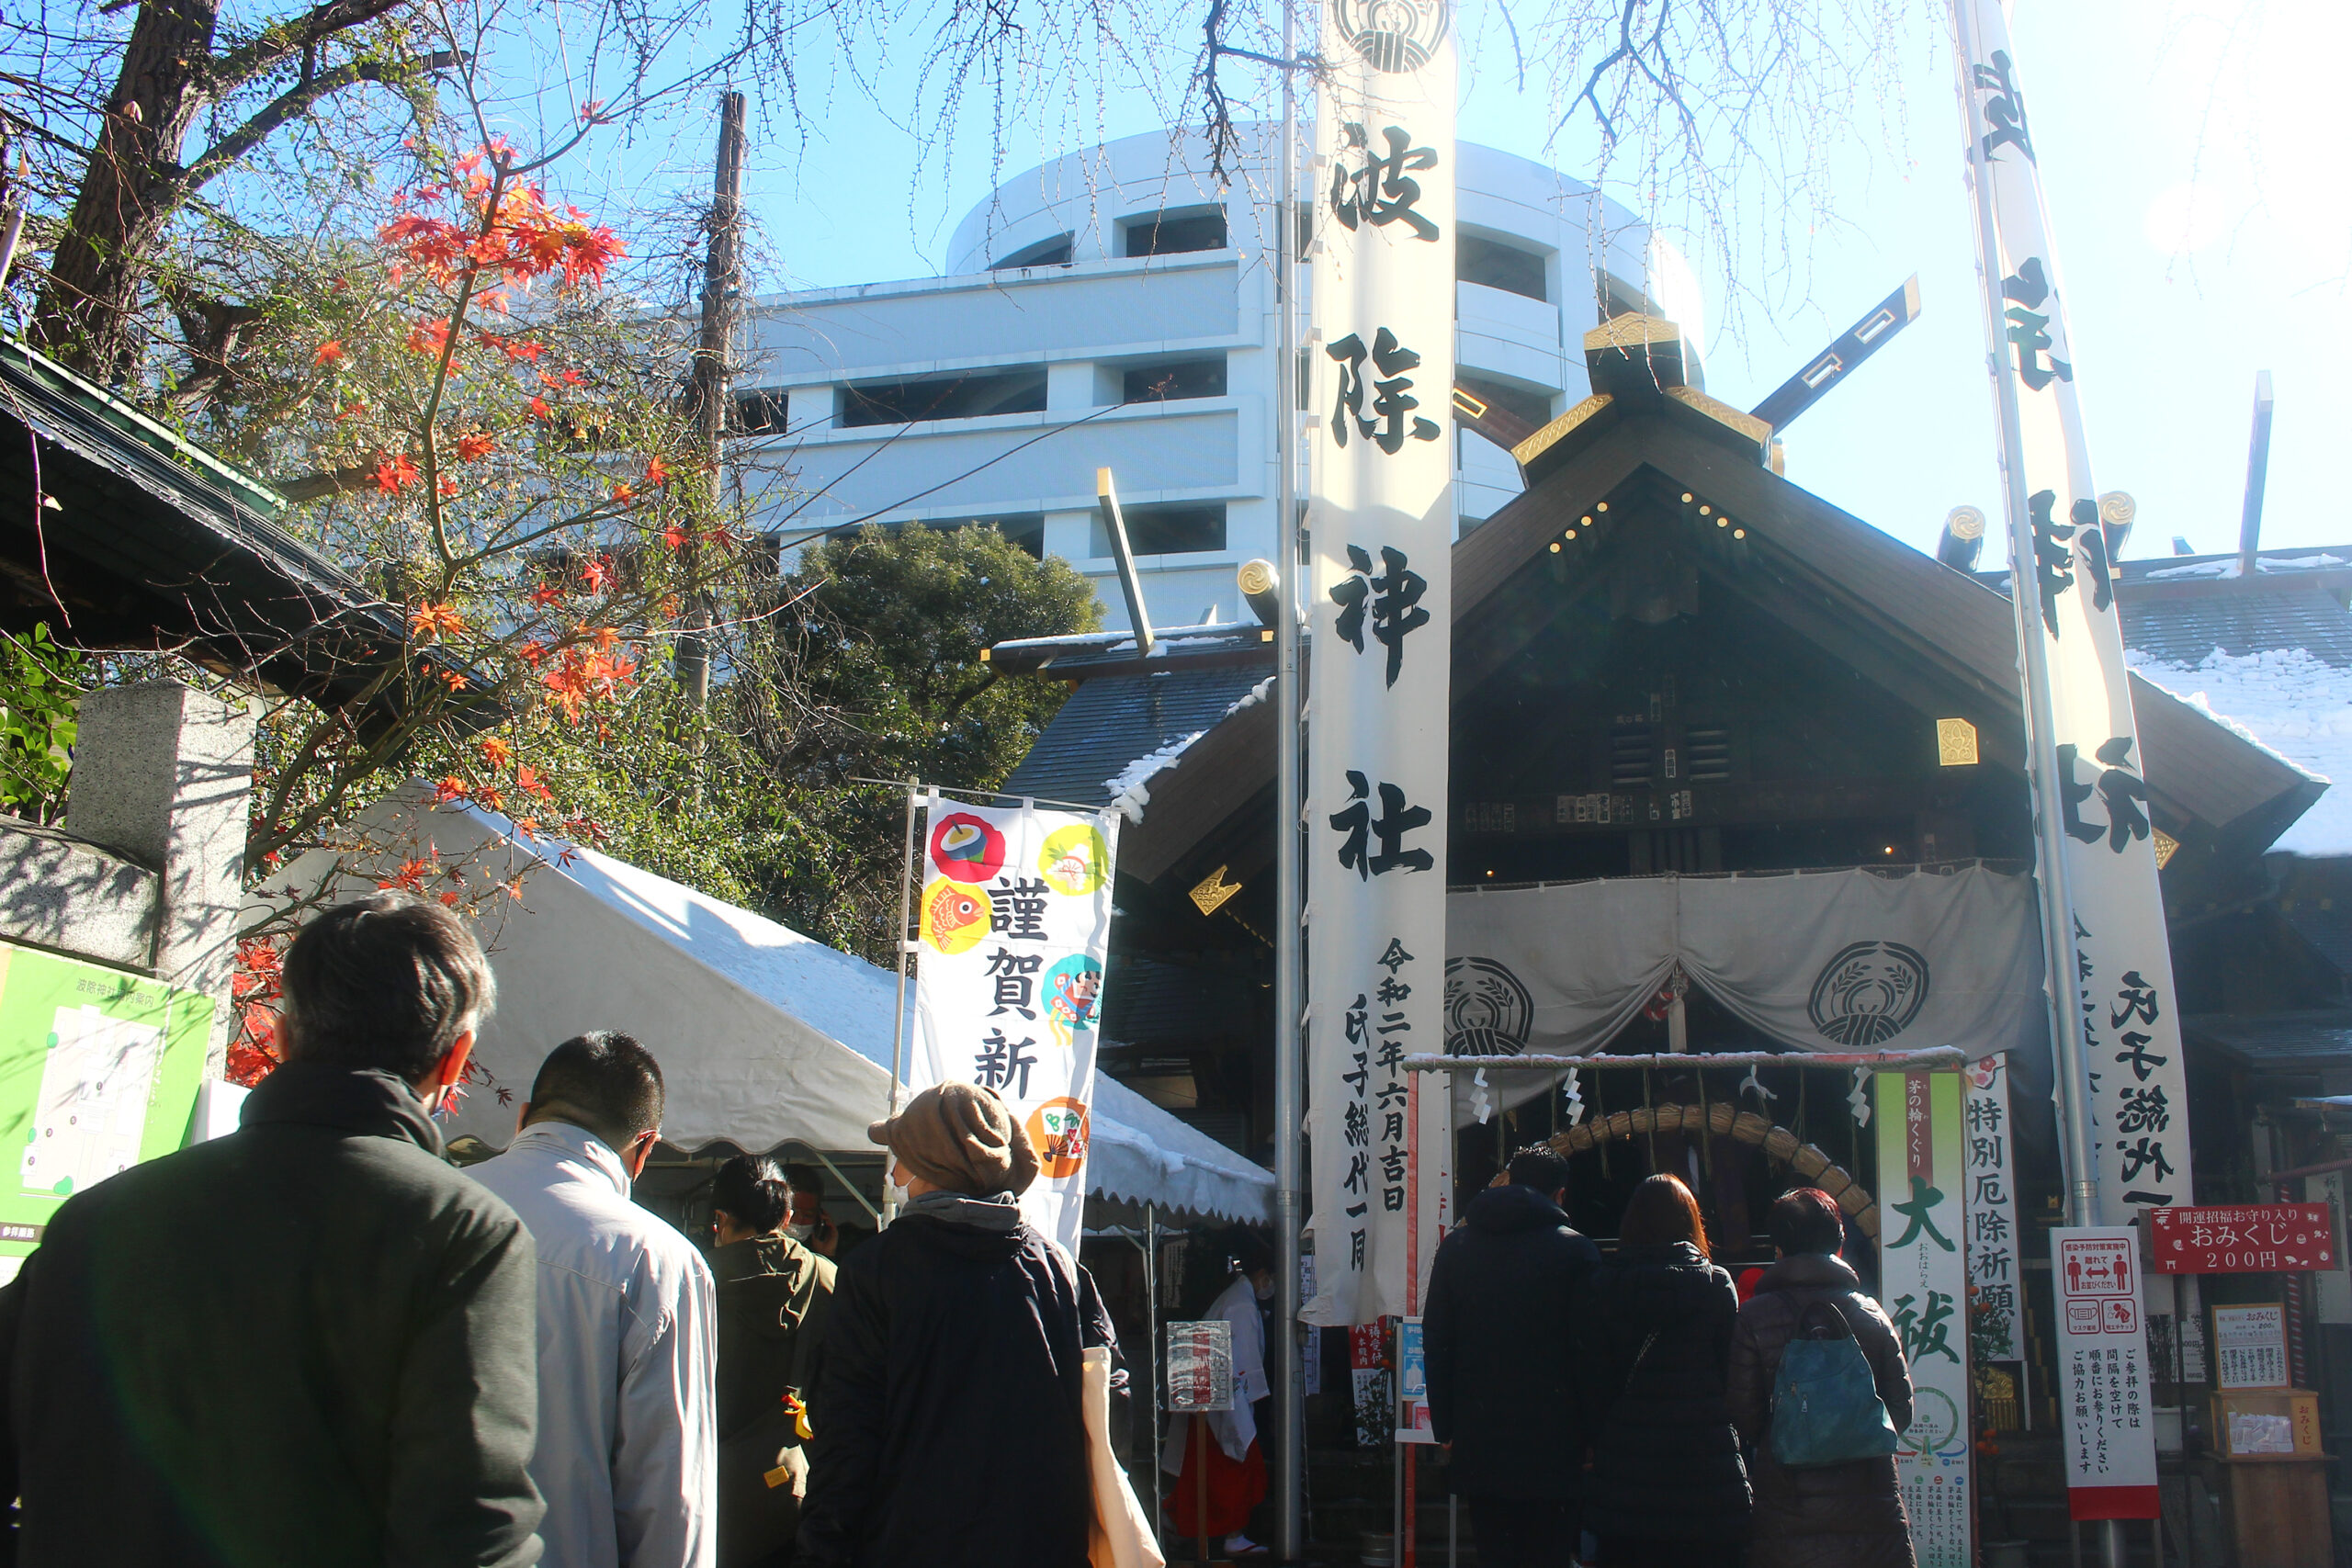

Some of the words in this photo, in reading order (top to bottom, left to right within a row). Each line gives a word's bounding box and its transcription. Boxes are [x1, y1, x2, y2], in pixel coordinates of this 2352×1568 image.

[1326, 122, 1442, 883] 波除神社
[974, 876, 1050, 1100] 謹賀新
[1375, 937, 1415, 1213] 令和二年六月吉日
[1342, 993, 1370, 1272] 氏子総代一同
[1907, 1079, 1924, 1168] 茅の輪くぐり
[1968, 1097, 2016, 1318] 特別厄除祈願
[2179, 1209, 2299, 1224] 開運招福お守り入り
[2190, 1223, 2289, 1247] おみくじ
[1884, 1174, 1961, 1368] 大祓
[1918, 1241, 1928, 1289] おおはらえ
[2085, 1256, 2109, 1264] 離れて
[2246, 1312, 2278, 1321] おみくじ
[2073, 1350, 2091, 1473] ご協力お願いします
[2089, 1349, 2109, 1473] 順番にお参りください
[2107, 1348, 2122, 1428] 間隔を空けて
[2125, 1348, 2141, 1428] ご参拝の際は
[2299, 1405, 2312, 1445] おみくじ
